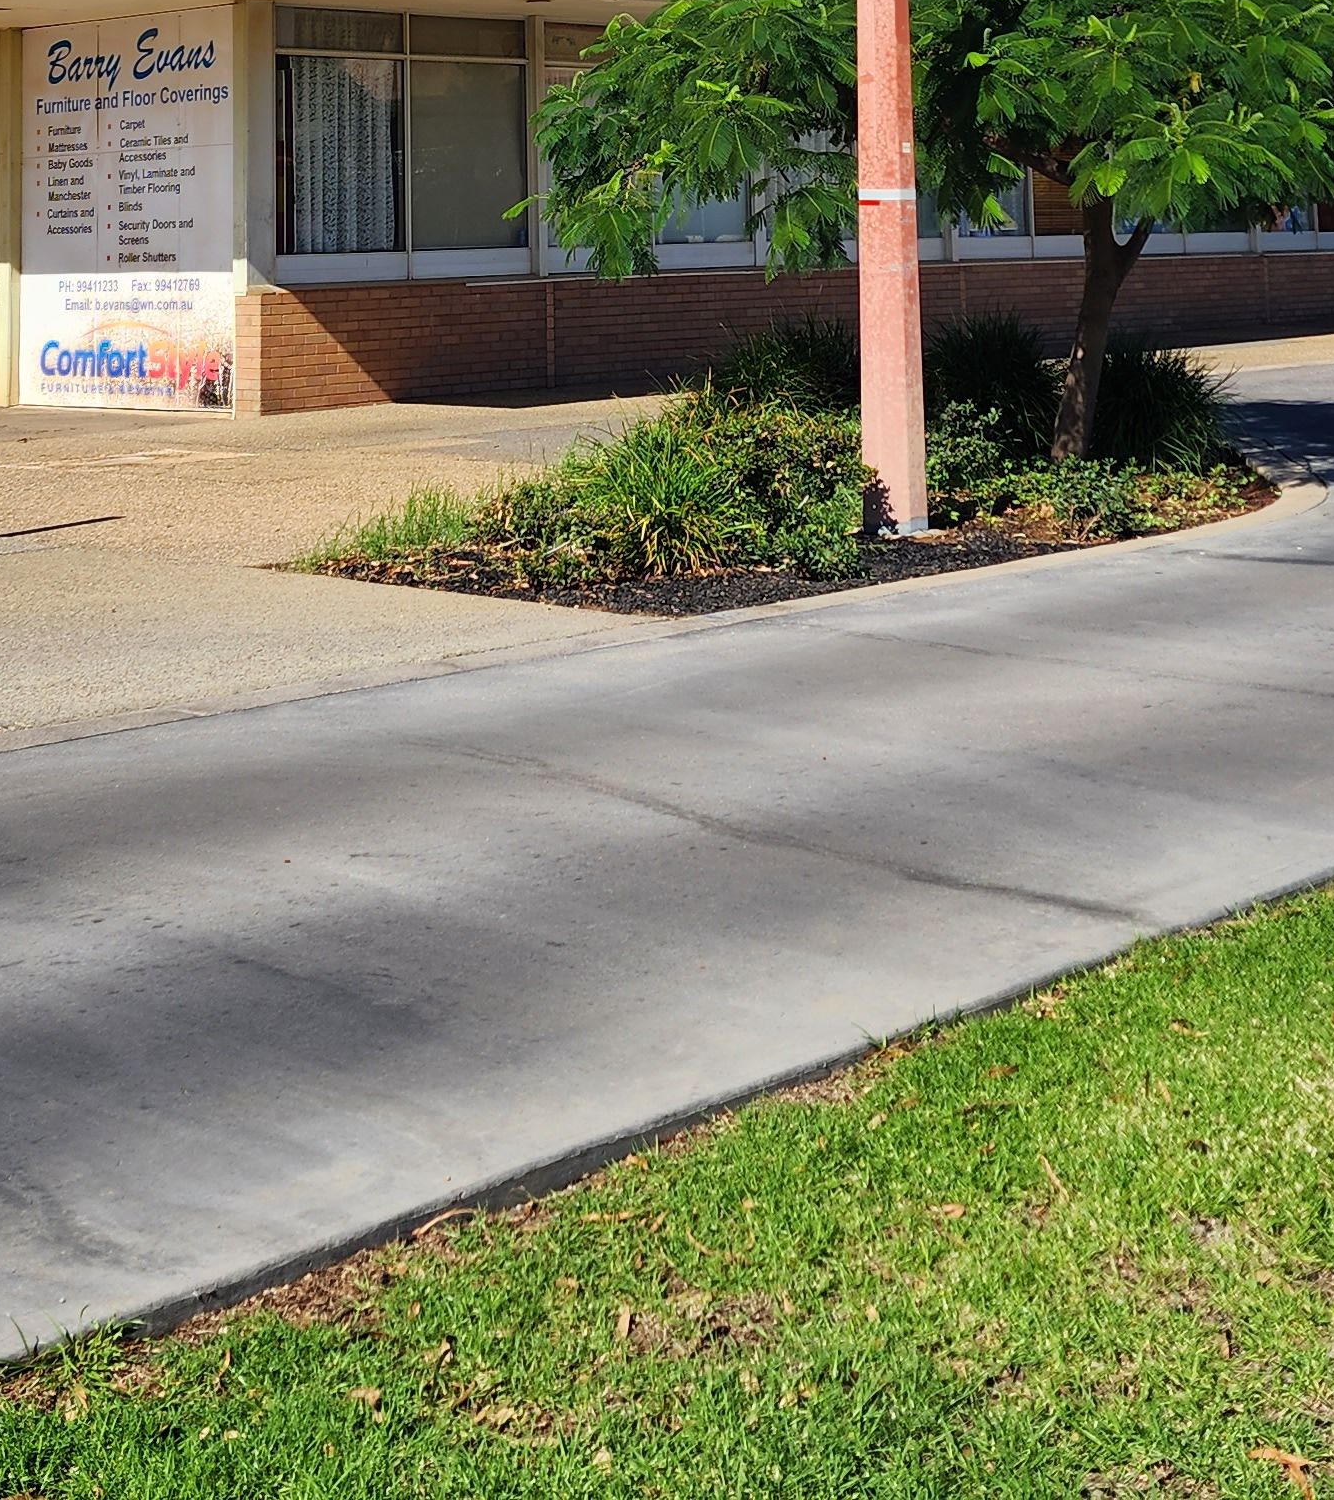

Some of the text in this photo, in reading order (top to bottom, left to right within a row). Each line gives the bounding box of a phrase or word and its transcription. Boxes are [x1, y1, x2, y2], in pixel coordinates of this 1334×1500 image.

[48, 27, 217, 92] Barry Evans
[36, 83, 229, 115] Furniture and Floor Coverings
[48, 125, 81, 136] Furniture
[119, 119, 146, 131] Carpet
[49, 141, 88, 153] Mattresses
[120, 133, 189, 149] Ceramic Tiles and
[48, 157, 94, 171] Baby Goods
[119, 151, 167, 163] Accessories
[143, 167, 178, 180] Laminate
[180, 165, 196, 177] and
[48, 174, 85, 187] Linen and
[49, 190, 91, 202] Manchester
[119, 182, 181, 196] Timber Flooring
[47, 206, 95, 220] Curtains and
[119, 201, 143, 212] Blinds
[47, 223, 93, 236] Accessories
[119, 217, 194, 232] Security Doors and
[119, 235, 149, 246] Screens
[119, 250, 176, 264] Roller Shutters
[59, 280, 74, 293] PH:
[76, 278, 118, 293] 99411233
[155, 277, 200, 292] 99412769
[65, 298, 92, 311] Email:
[40, 339, 221, 391] ComfortStyle
